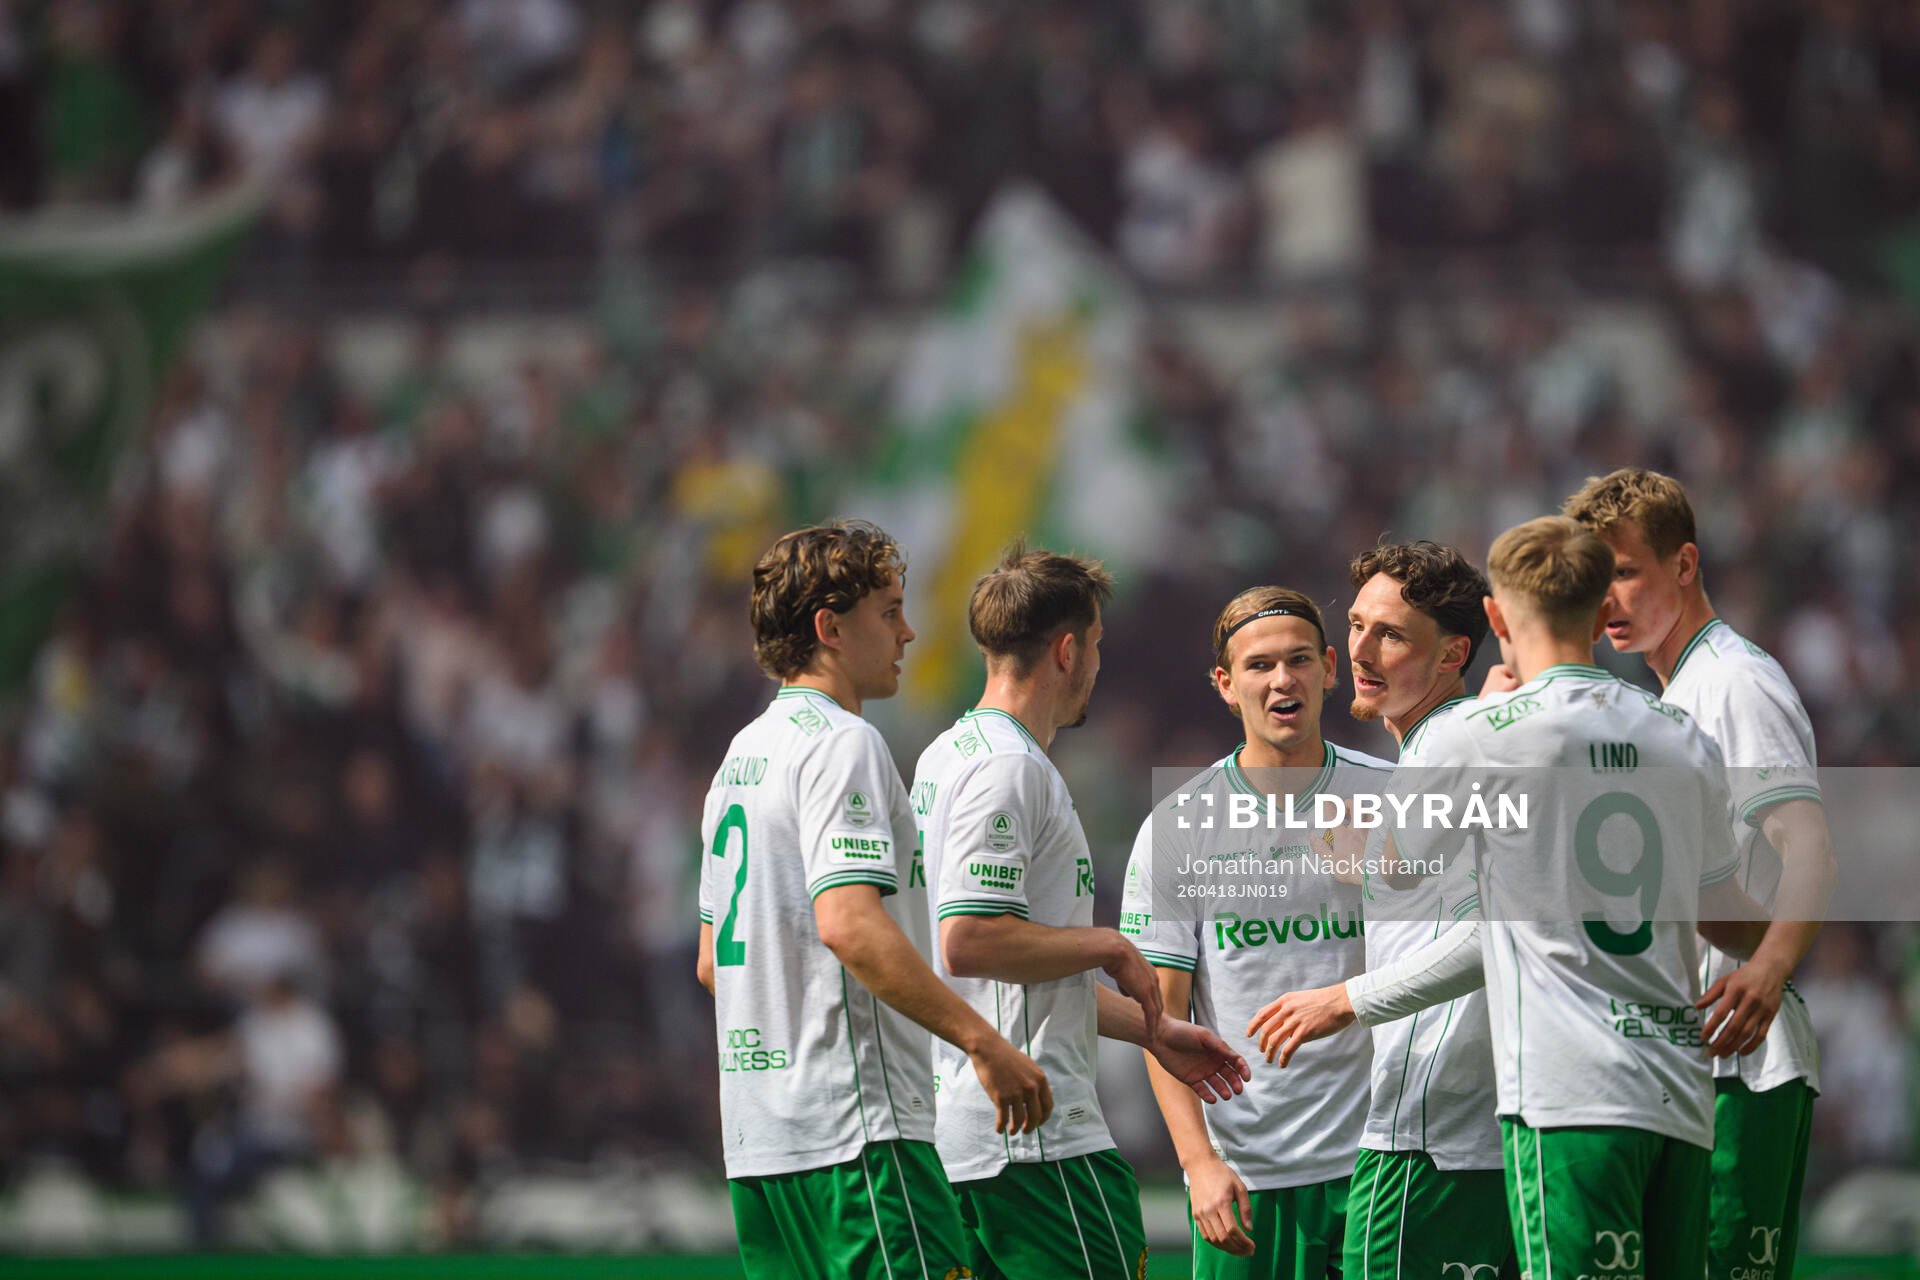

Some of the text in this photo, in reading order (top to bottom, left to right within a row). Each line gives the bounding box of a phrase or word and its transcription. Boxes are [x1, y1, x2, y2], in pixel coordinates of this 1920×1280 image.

[1258, 609, 1283, 617] CRAFT
[1589, 742, 1638, 774] LIND
[832, 837, 890, 853] UNIBET
[969, 863, 1023, 881] UNIBET
[1575, 792, 1663, 956] 9
[712, 804, 748, 967] 2
